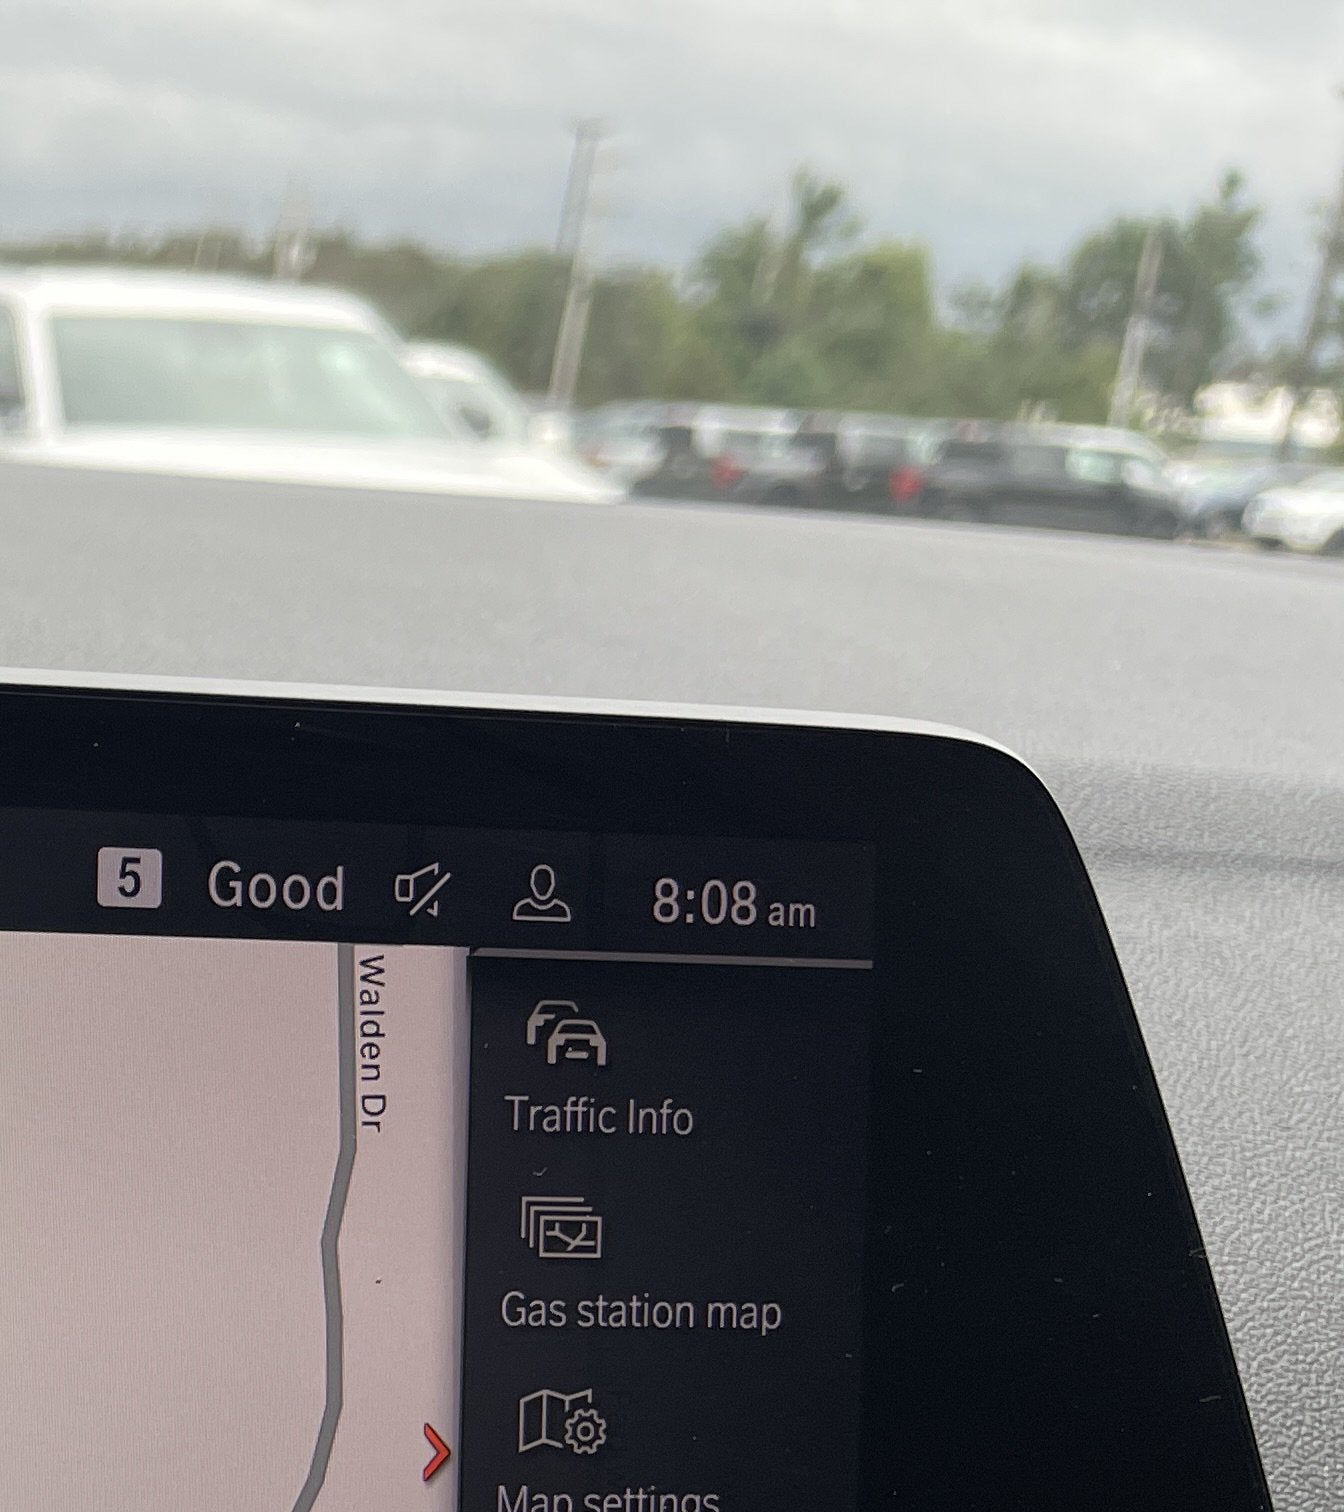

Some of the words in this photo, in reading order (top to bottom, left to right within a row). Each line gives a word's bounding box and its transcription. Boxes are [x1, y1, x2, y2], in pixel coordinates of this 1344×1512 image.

[118, 856, 142, 898] 5
[209, 860, 344, 911] Good
[653, 877, 758, 926] 8:08
[768, 899, 816, 928] am
[359, 954, 386, 1082] Walden
[361, 1094, 386, 1133] Dr
[504, 1095, 616, 1134] Traffic
[628, 1098, 694, 1136] Info
[500, 1290, 567, 1328] Gas
[577, 1294, 695, 1330] station
[707, 1300, 782, 1336] map
